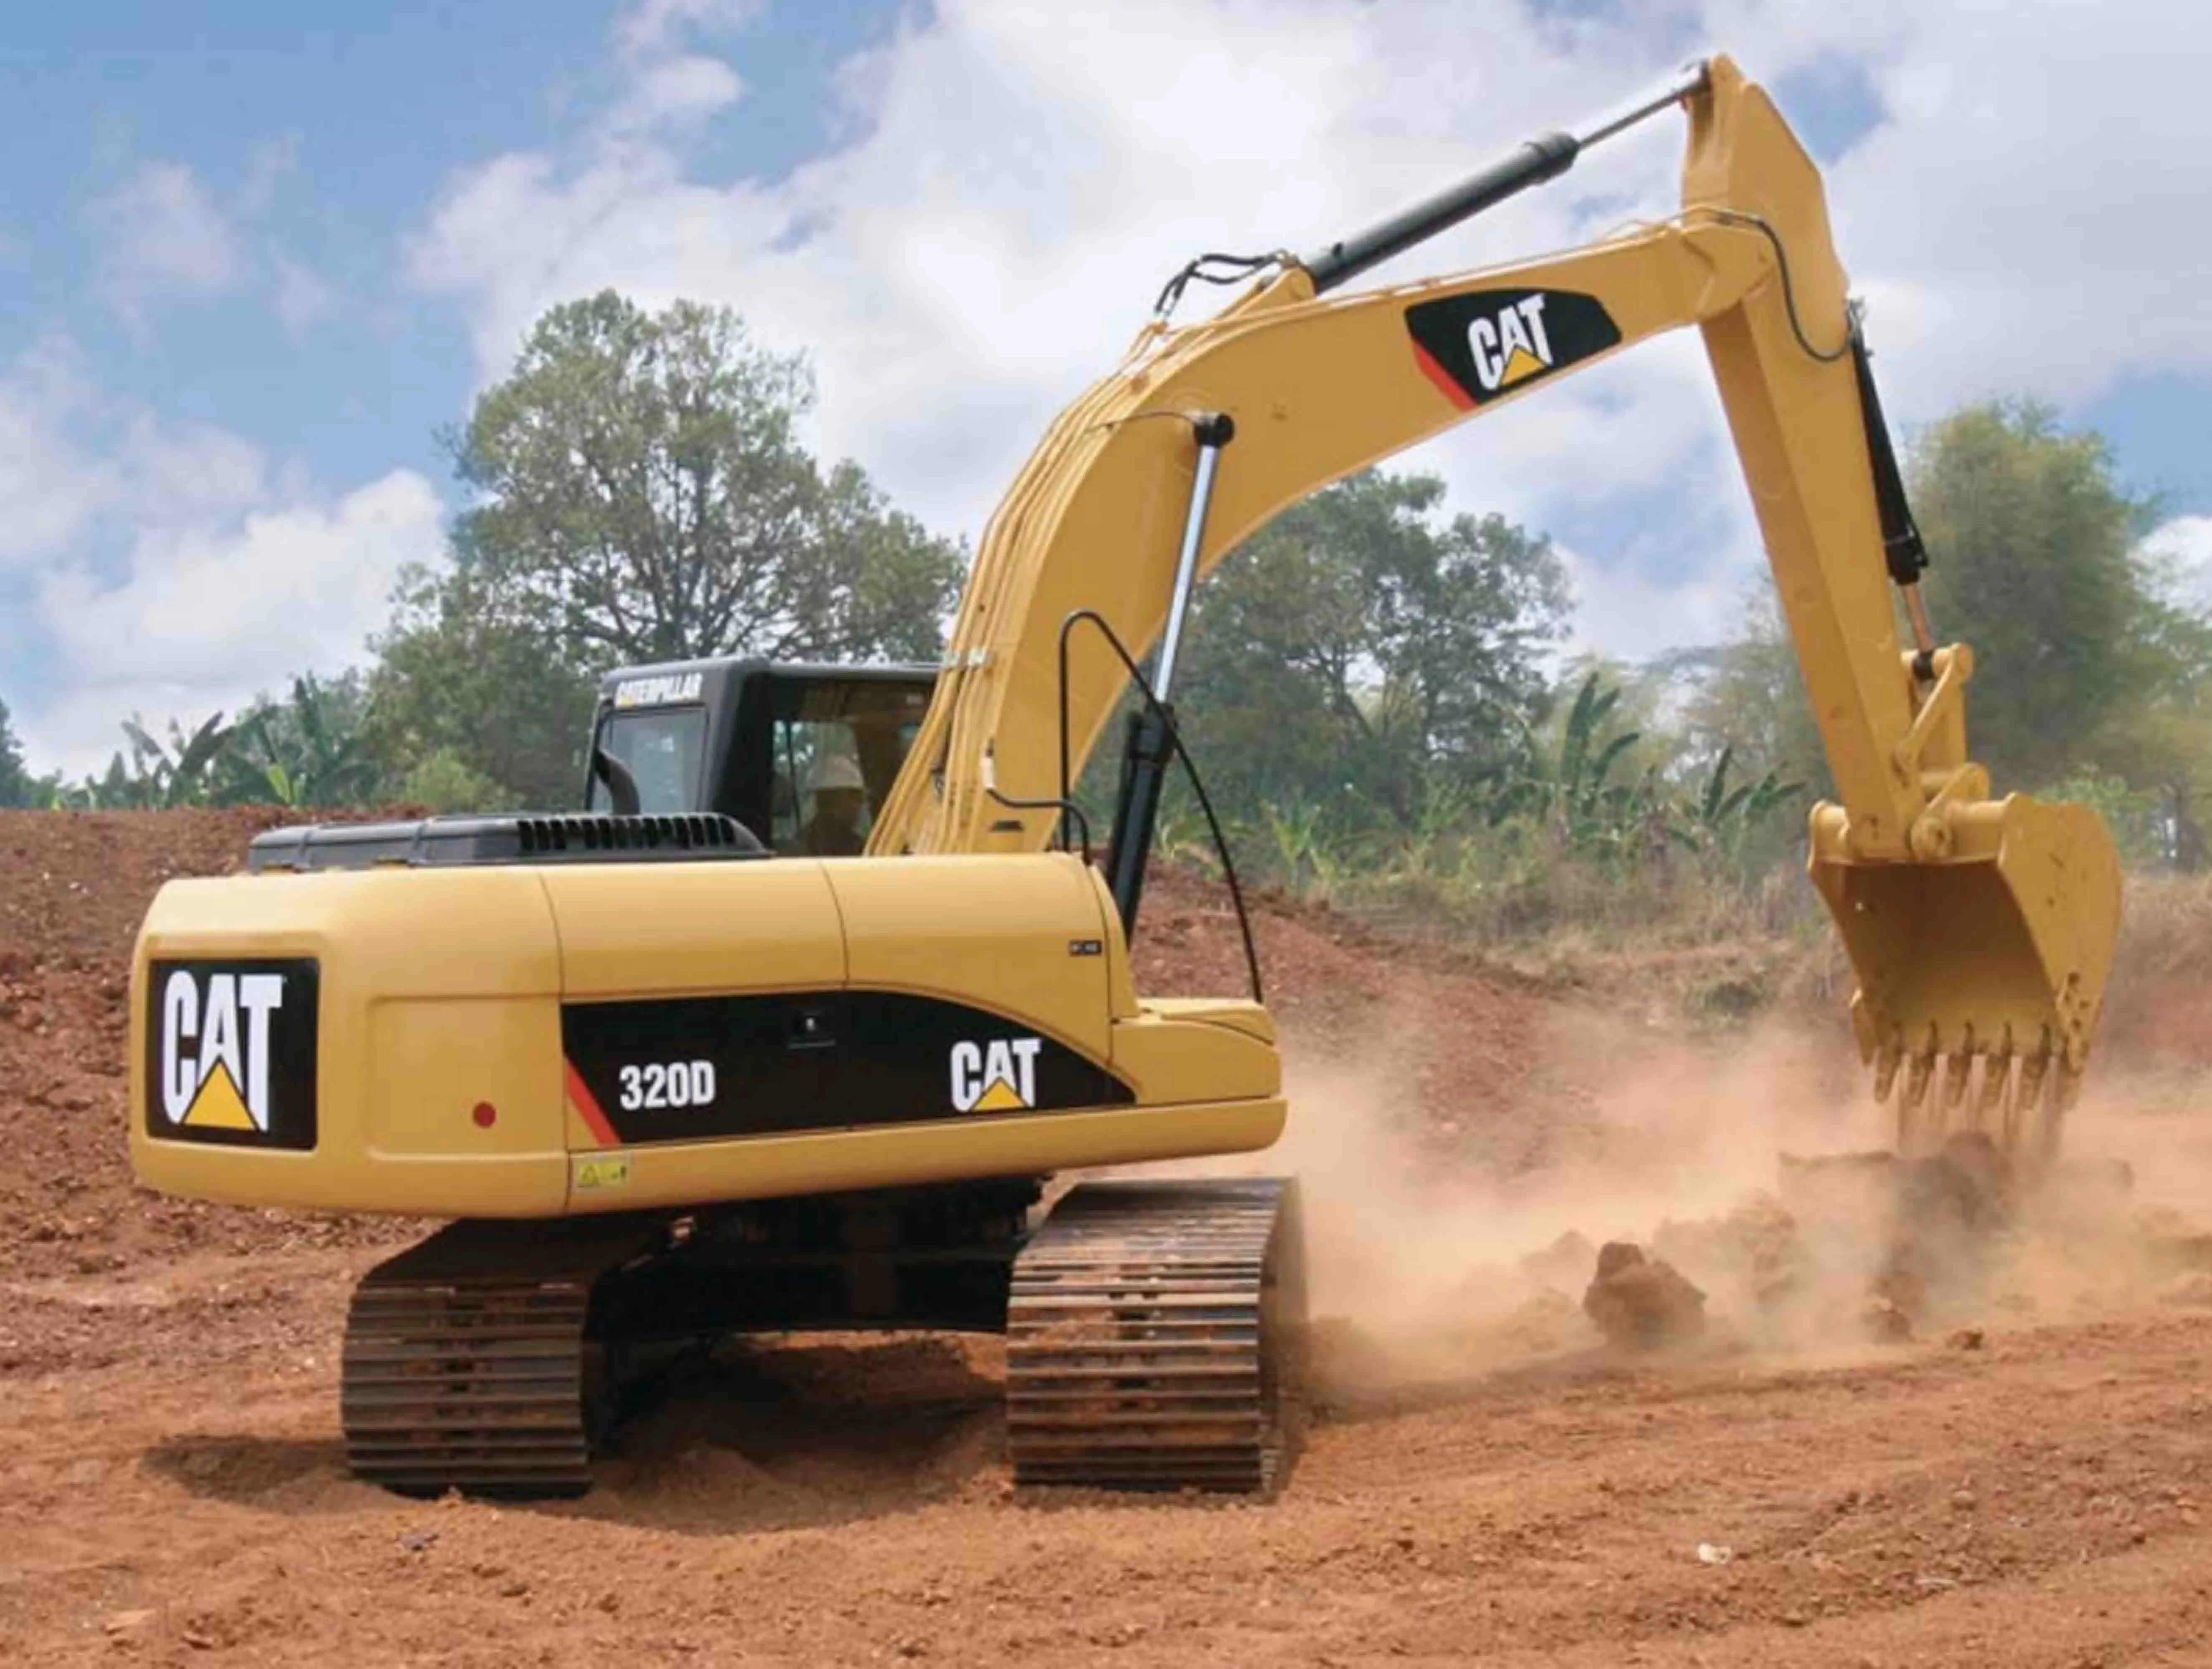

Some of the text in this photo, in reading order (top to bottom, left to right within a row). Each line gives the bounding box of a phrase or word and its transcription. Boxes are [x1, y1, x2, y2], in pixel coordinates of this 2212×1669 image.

[1468, 293, 1553, 391] CAT
[163, 970, 284, 1131] CAT
[619, 1061, 715, 1110] 320D
[951, 1038, 1041, 1112] CAT
